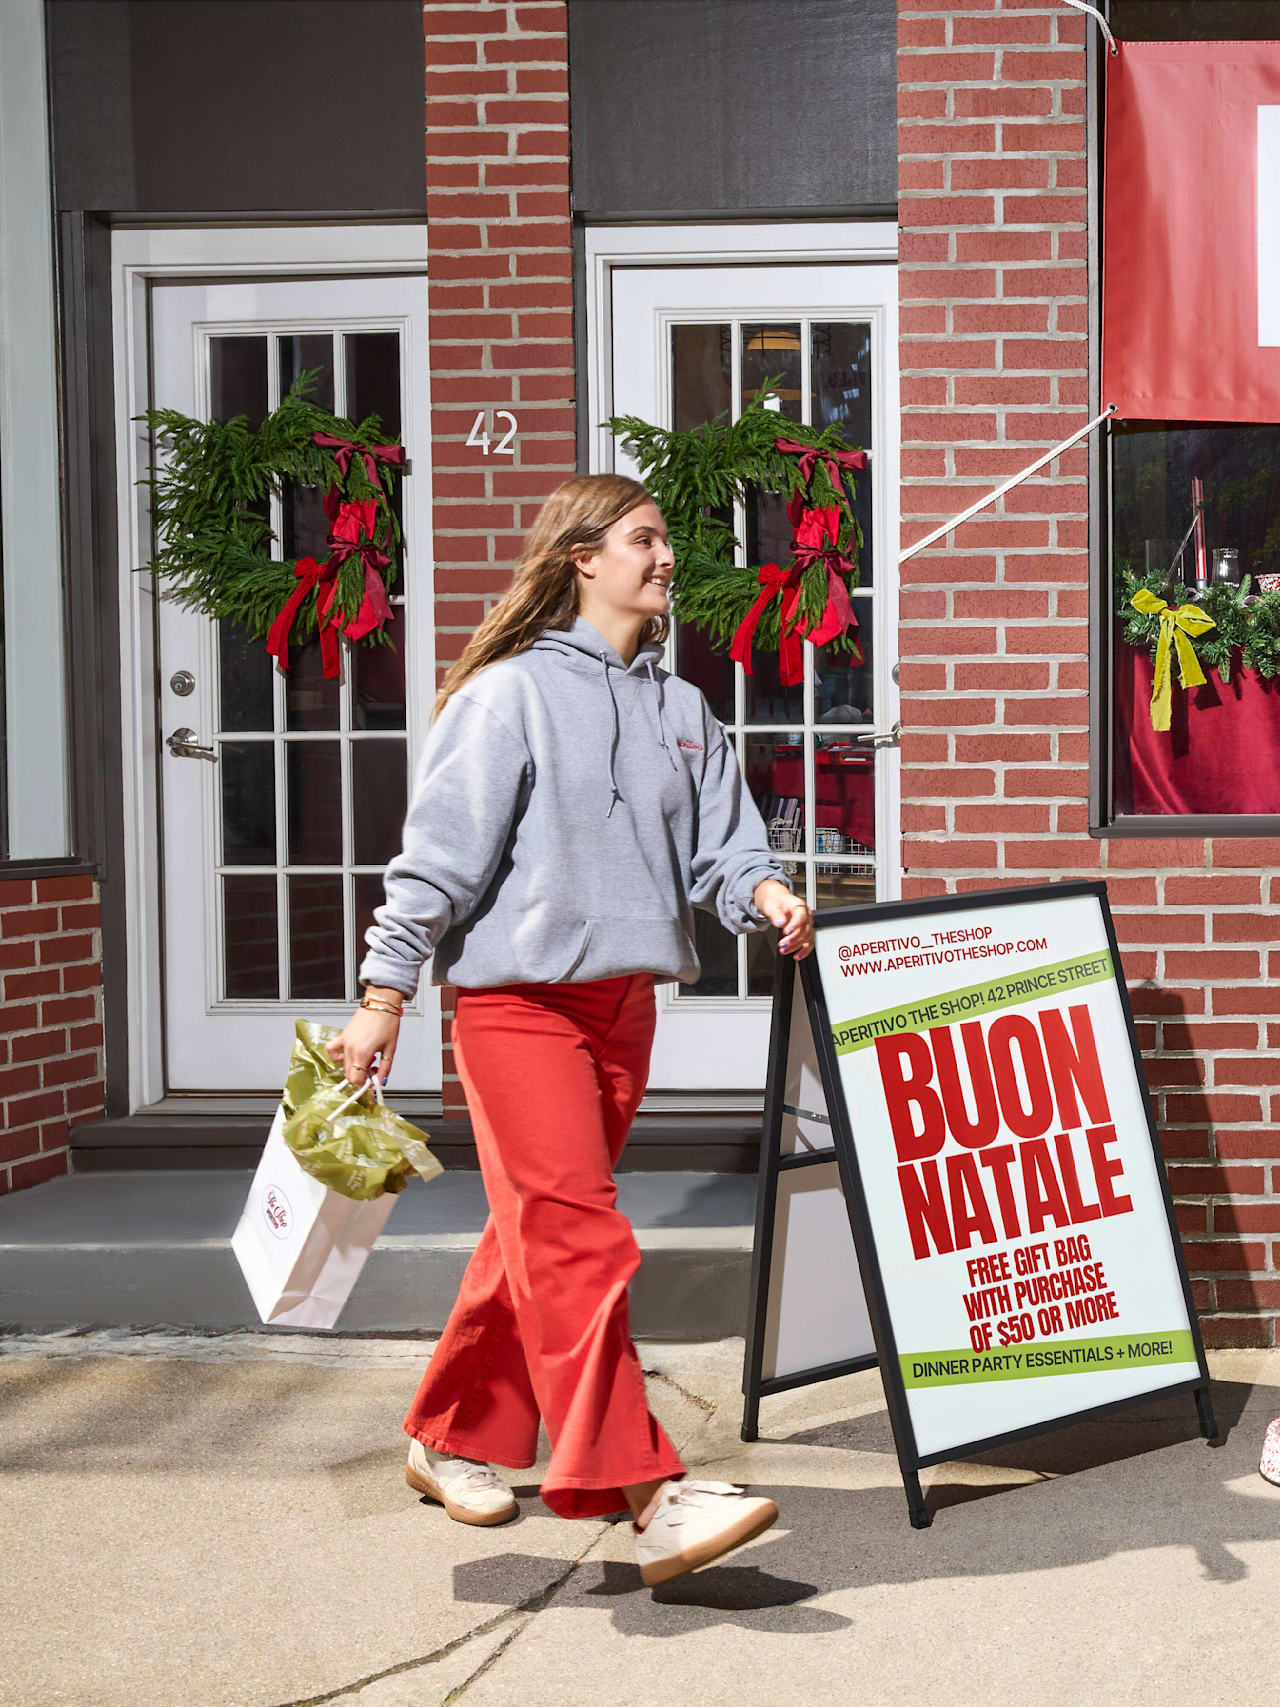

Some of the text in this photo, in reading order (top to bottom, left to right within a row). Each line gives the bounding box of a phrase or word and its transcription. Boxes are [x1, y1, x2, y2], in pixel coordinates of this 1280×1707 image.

[465, 410, 518, 455] 42
[840, 937, 1048, 978] WWW.APERITIVOTHESHOP.COM
[831, 958, 1109, 1047] APERITIVO THE SHOP! 42 PRINCE STREET
[874, 1004, 1112, 1163] BUON
[897, 1124, 1134, 1260] NATALE
[962, 1261, 1108, 1322] WITH PURCHASE
[966, 1234, 1092, 1288] FREE GIFT BAG
[969, 1291, 1120, 1354] OF $50 OR MORE
[913, 1340, 1173, 1378] DINNER PARTY ESSENTIALS + MORE!
